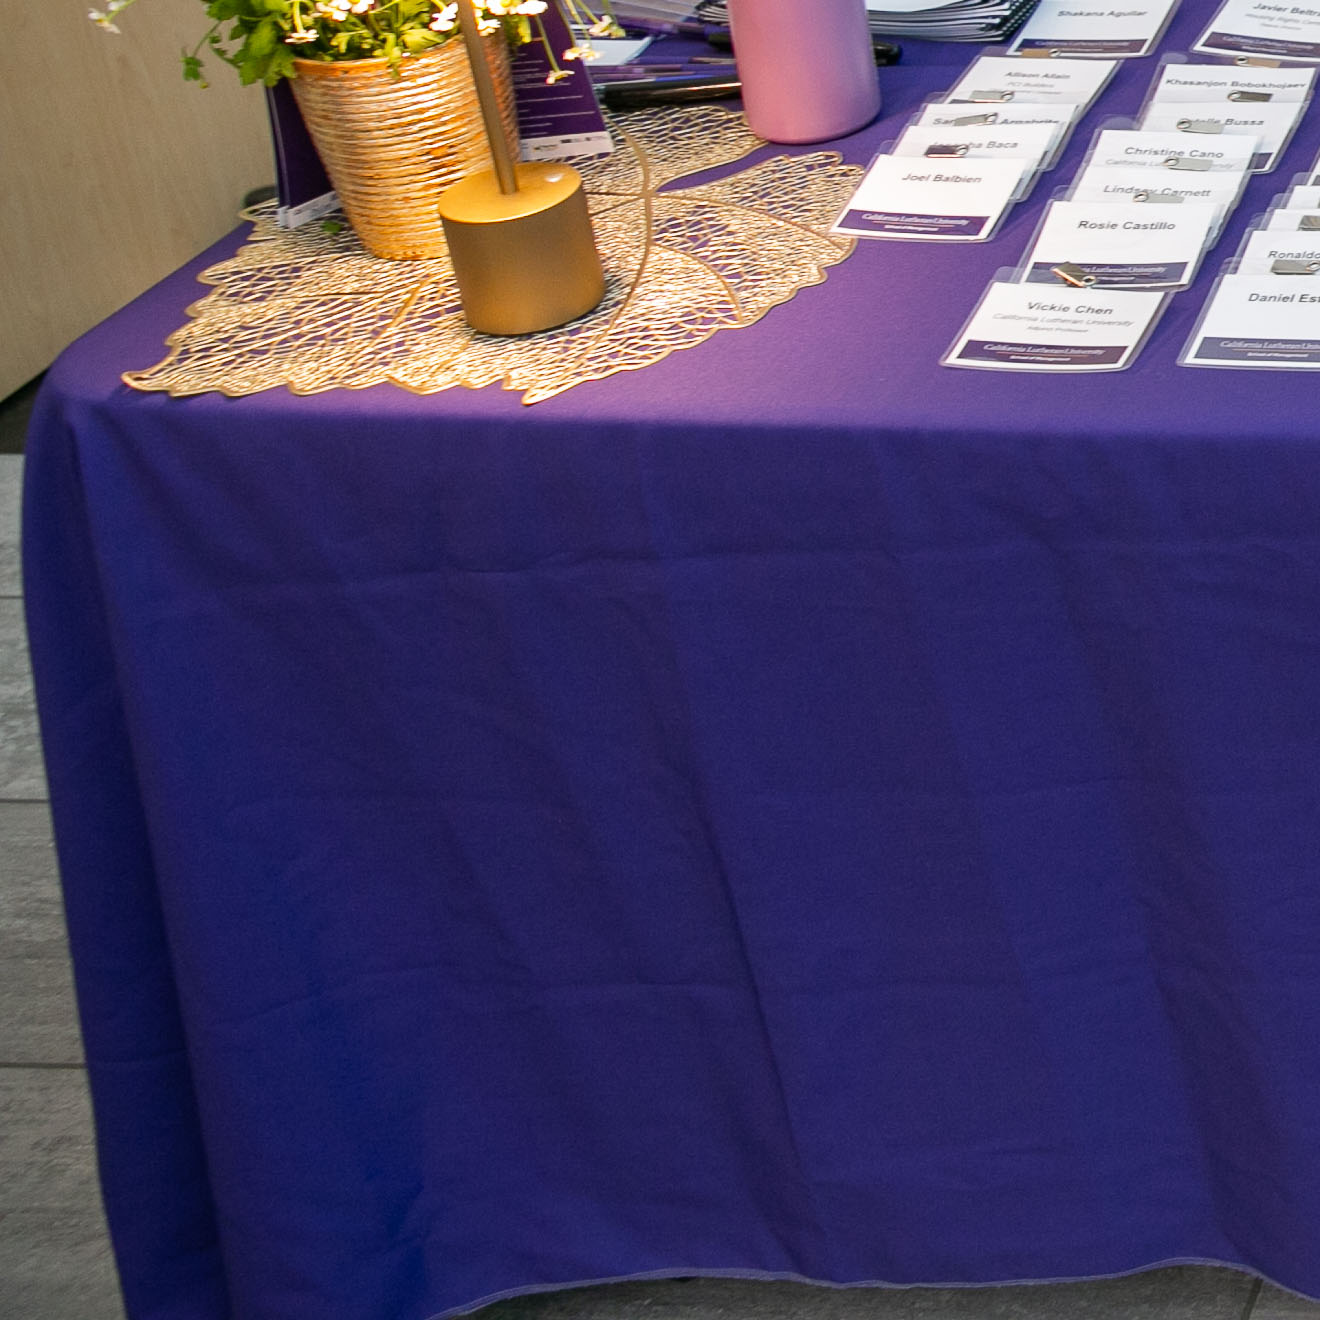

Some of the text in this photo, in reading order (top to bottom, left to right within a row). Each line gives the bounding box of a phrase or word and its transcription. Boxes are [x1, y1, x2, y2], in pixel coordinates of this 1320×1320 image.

[1254, 4, 1289, 13] Javier
[1125, 147, 1184, 157] Christine
[902, 173, 982, 183] Joel Balbien
[1078, 221, 1176, 230] Rosie Castillo
[1248, 293, 1294, 302] Daniel
[1028, 302, 1113, 315] Vickie Chen
